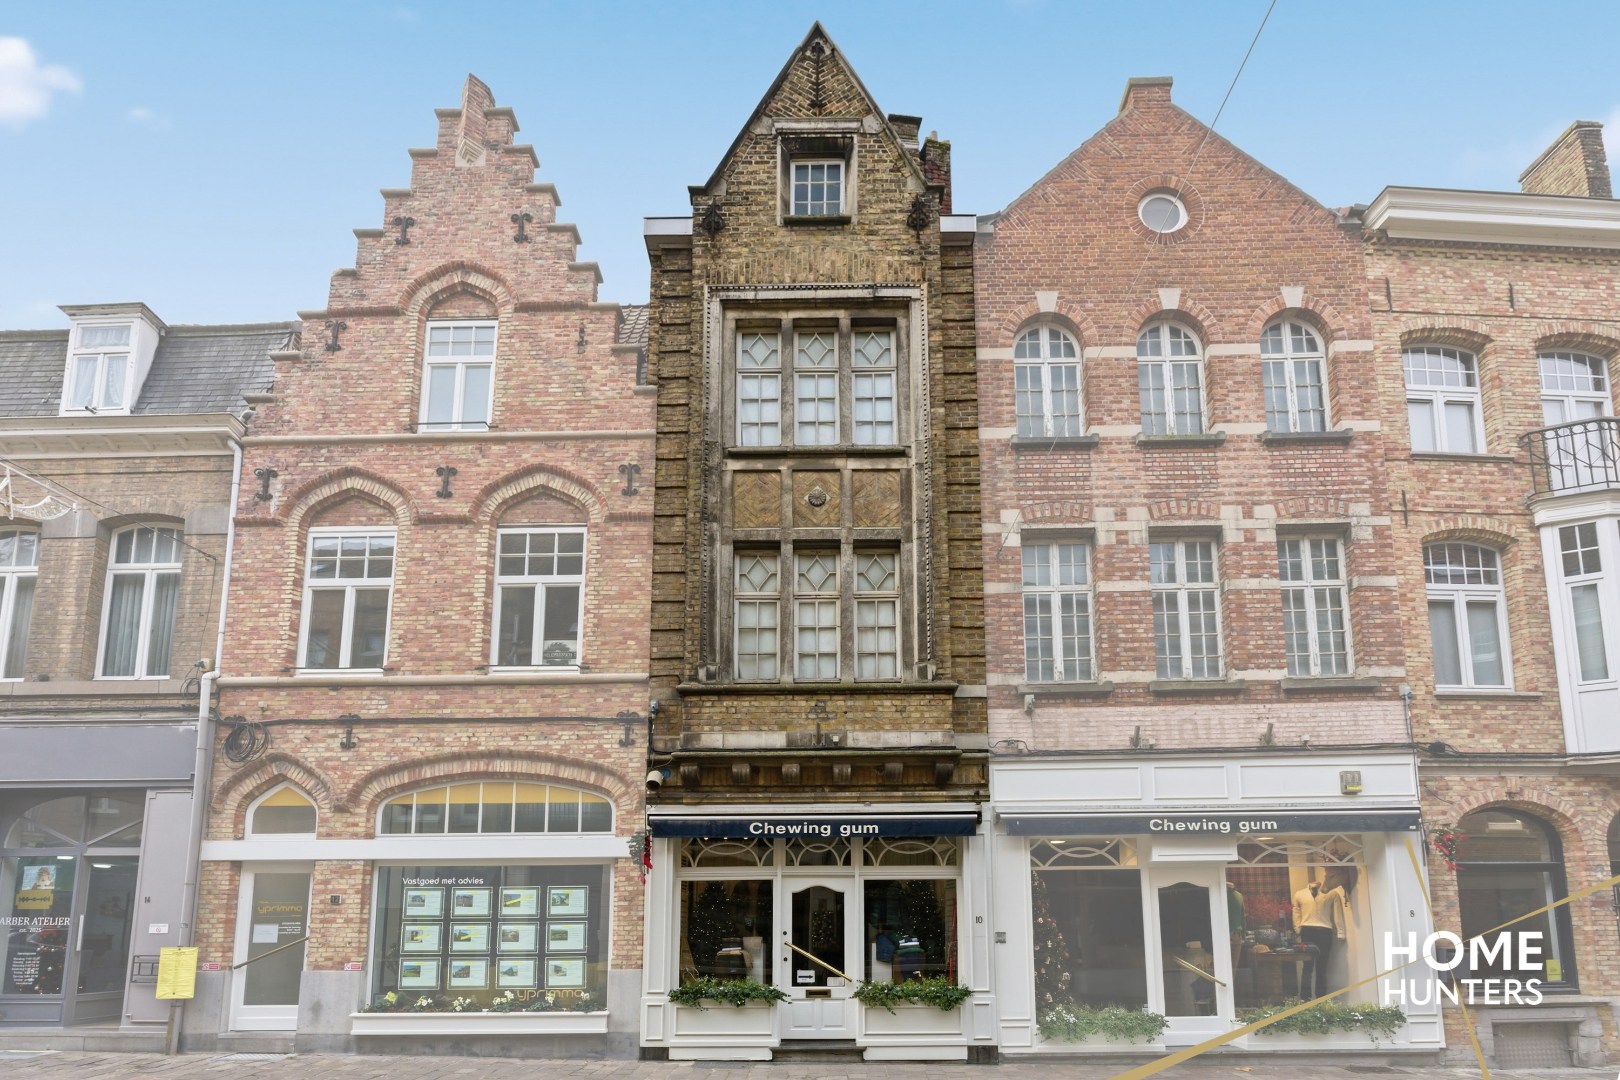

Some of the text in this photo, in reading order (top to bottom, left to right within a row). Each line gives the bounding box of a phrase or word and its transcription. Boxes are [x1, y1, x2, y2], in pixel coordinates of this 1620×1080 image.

[749, 821, 879, 837] Chewing gum
[1149, 818, 1278, 833] Chewing gum
[402, 876, 484, 886] Vastgoed met advies
[257, 905, 303, 914] yprimmo
[1409, 909, 1415, 918] 8
[31, 917, 71, 926] ATELIER
[975, 916, 983, 924] 10
